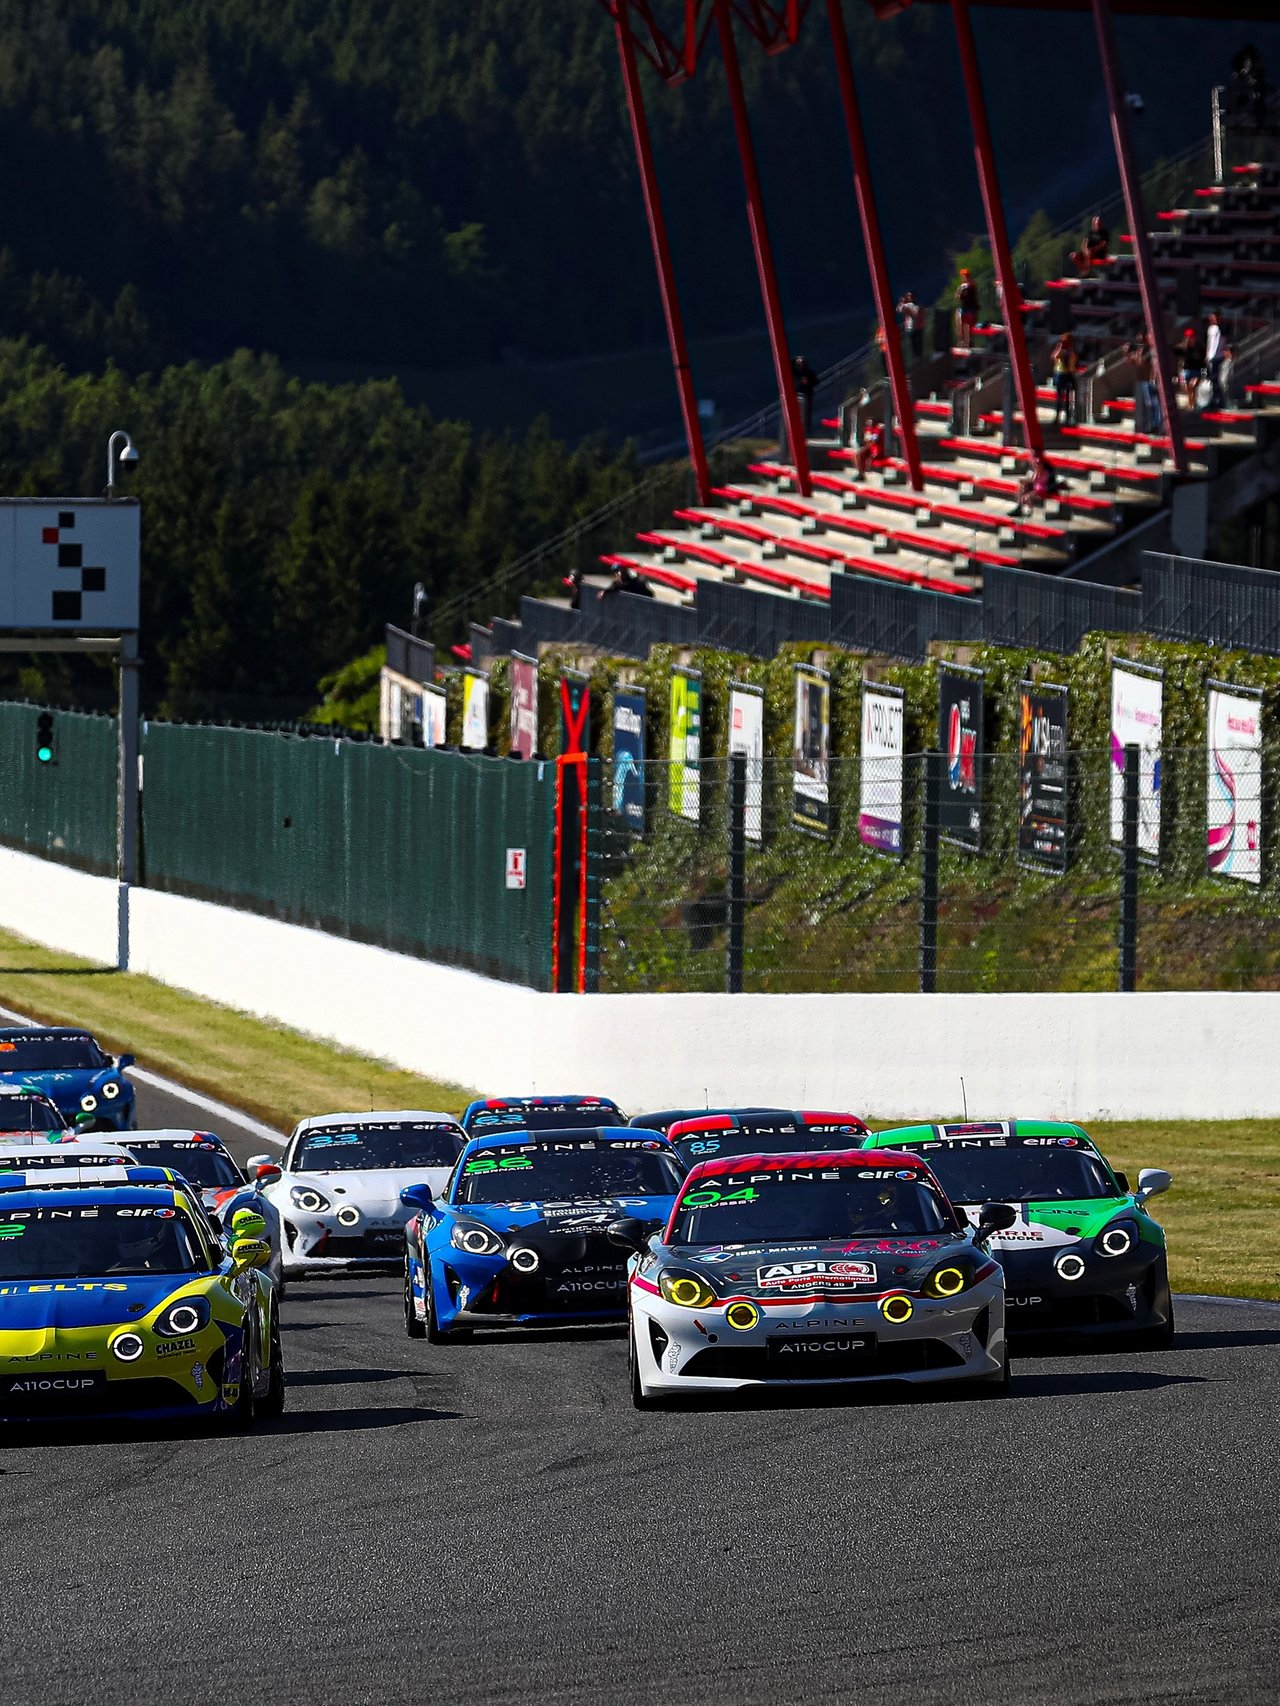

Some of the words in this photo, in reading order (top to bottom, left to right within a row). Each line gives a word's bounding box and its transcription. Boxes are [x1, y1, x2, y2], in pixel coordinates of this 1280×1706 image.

[681, 1126, 796, 1140] ALPINE
[809, 1125, 840, 1133] elf
[690, 1140, 720, 1153] 85
[1023, 1137, 1057, 1146] elf
[477, 1143, 597, 1158] ALPINE
[610, 1141, 641, 1149] elf
[78, 1156, 109, 1165] elf
[465, 1156, 533, 1172] 86
[700, 1172, 840, 1188] ALPINE
[858, 1170, 895, 1179] elf
[682, 1188, 760, 1206] 04
[116, 1208, 154, 1218] elf
[764, 1262, 826, 1278] API
[775, 1318, 864, 1329] ALPINE
[155, 1338, 196, 1354] CHAZEL
[779, 1341, 865, 1353] A110CUP
[8, 1351, 98, 1363] ALPINE
[9, 1379, 95, 1393] A110CUP
